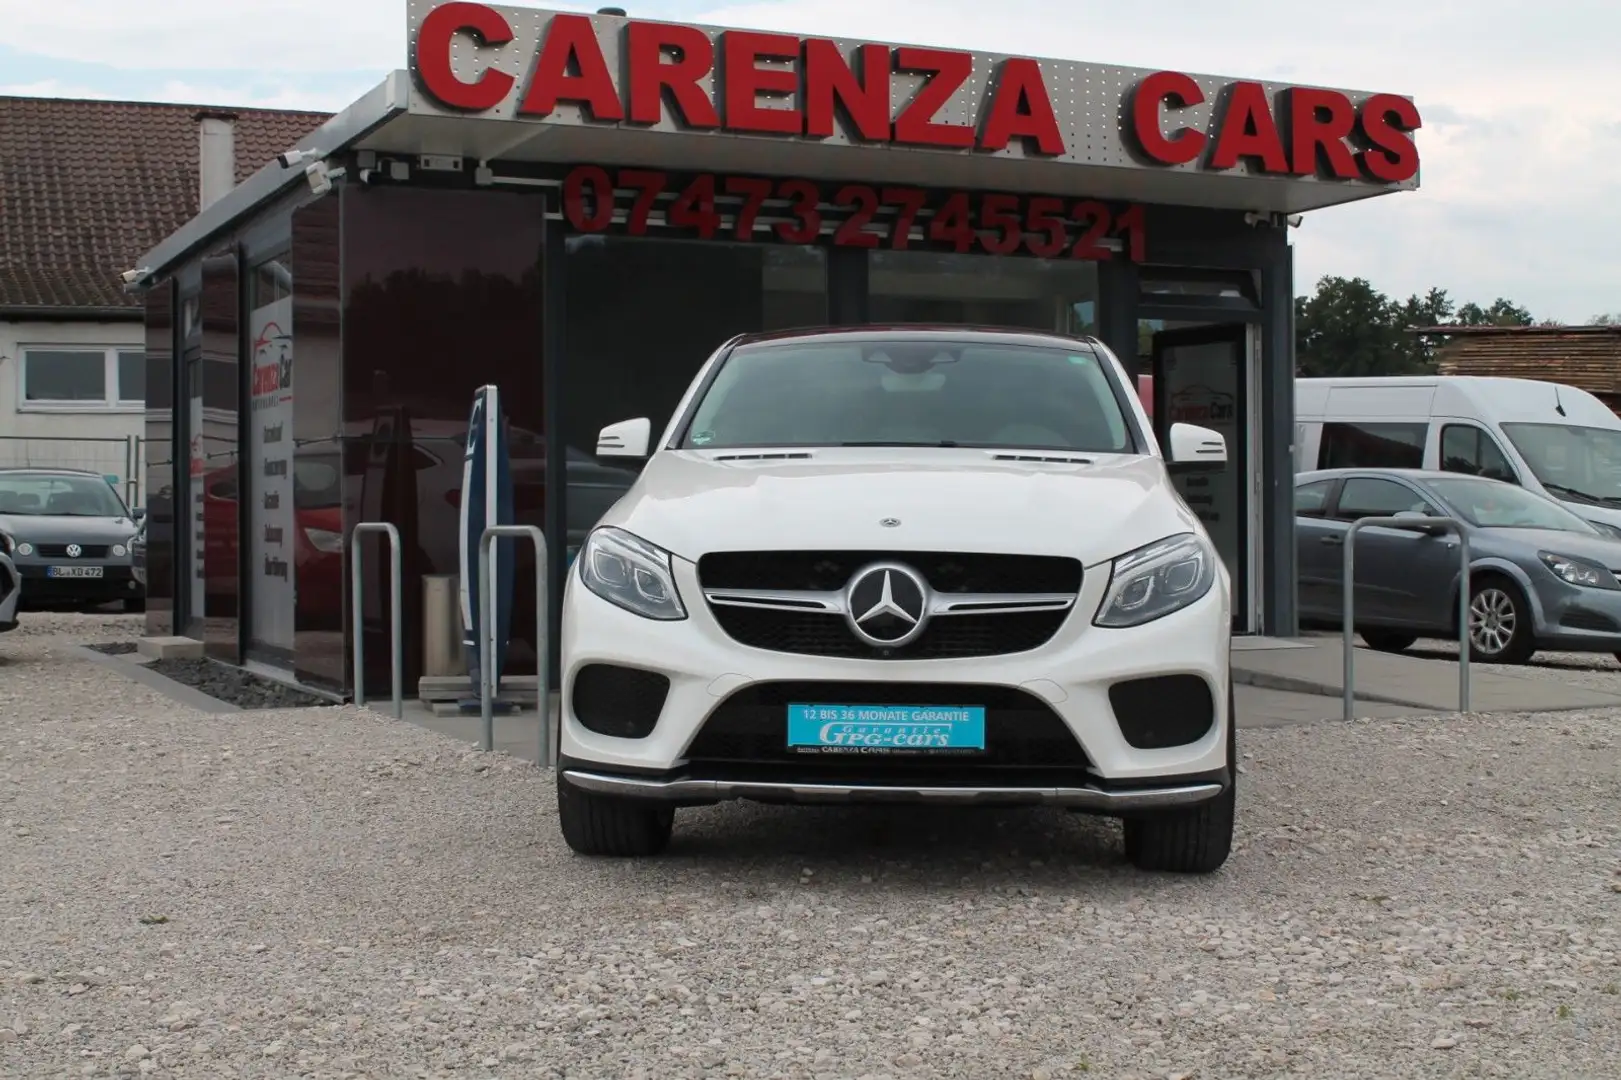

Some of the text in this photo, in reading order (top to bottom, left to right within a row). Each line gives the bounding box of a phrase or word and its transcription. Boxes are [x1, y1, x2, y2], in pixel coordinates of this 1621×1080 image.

[416, 1, 1421, 182] CARENZA CARS
[52, 568, 65, 577] BL
[803, 709, 969, 721] 12 BIS 36 MONATE GARANTIE
